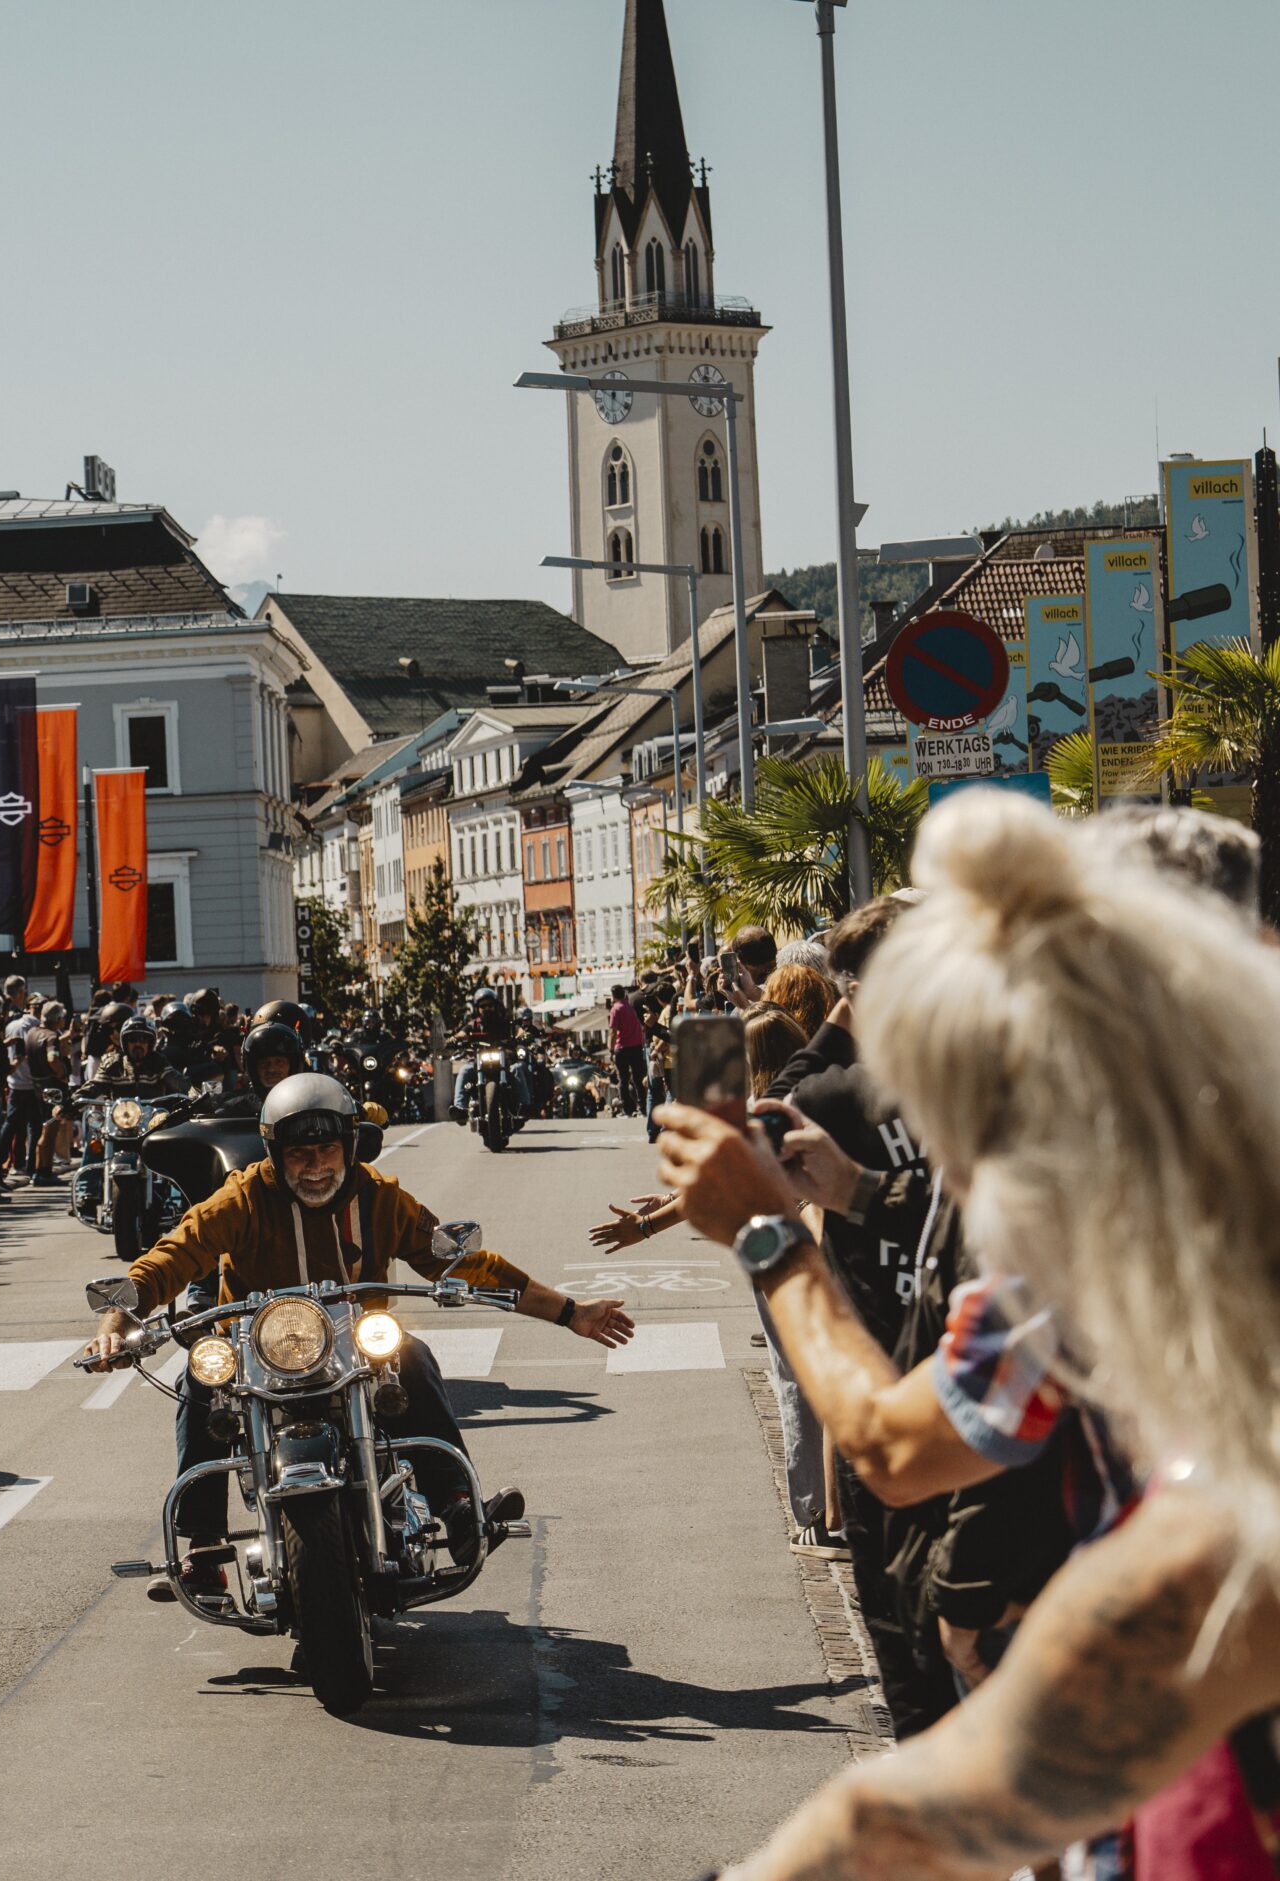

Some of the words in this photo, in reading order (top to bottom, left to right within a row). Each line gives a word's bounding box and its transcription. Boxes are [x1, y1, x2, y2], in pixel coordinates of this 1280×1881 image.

[1193, 480, 1238, 495] villach
[1108, 555, 1146, 568] villach
[1045, 608, 1078, 619] villach
[928, 714, 976, 730] ENDE
[915, 736, 990, 757] WERKTAGS
[1101, 746, 1118, 755] WIE
[916, 761, 933, 774] VON
[975, 757, 991, 769] UHR
[297, 907, 312, 995] HOTEL
